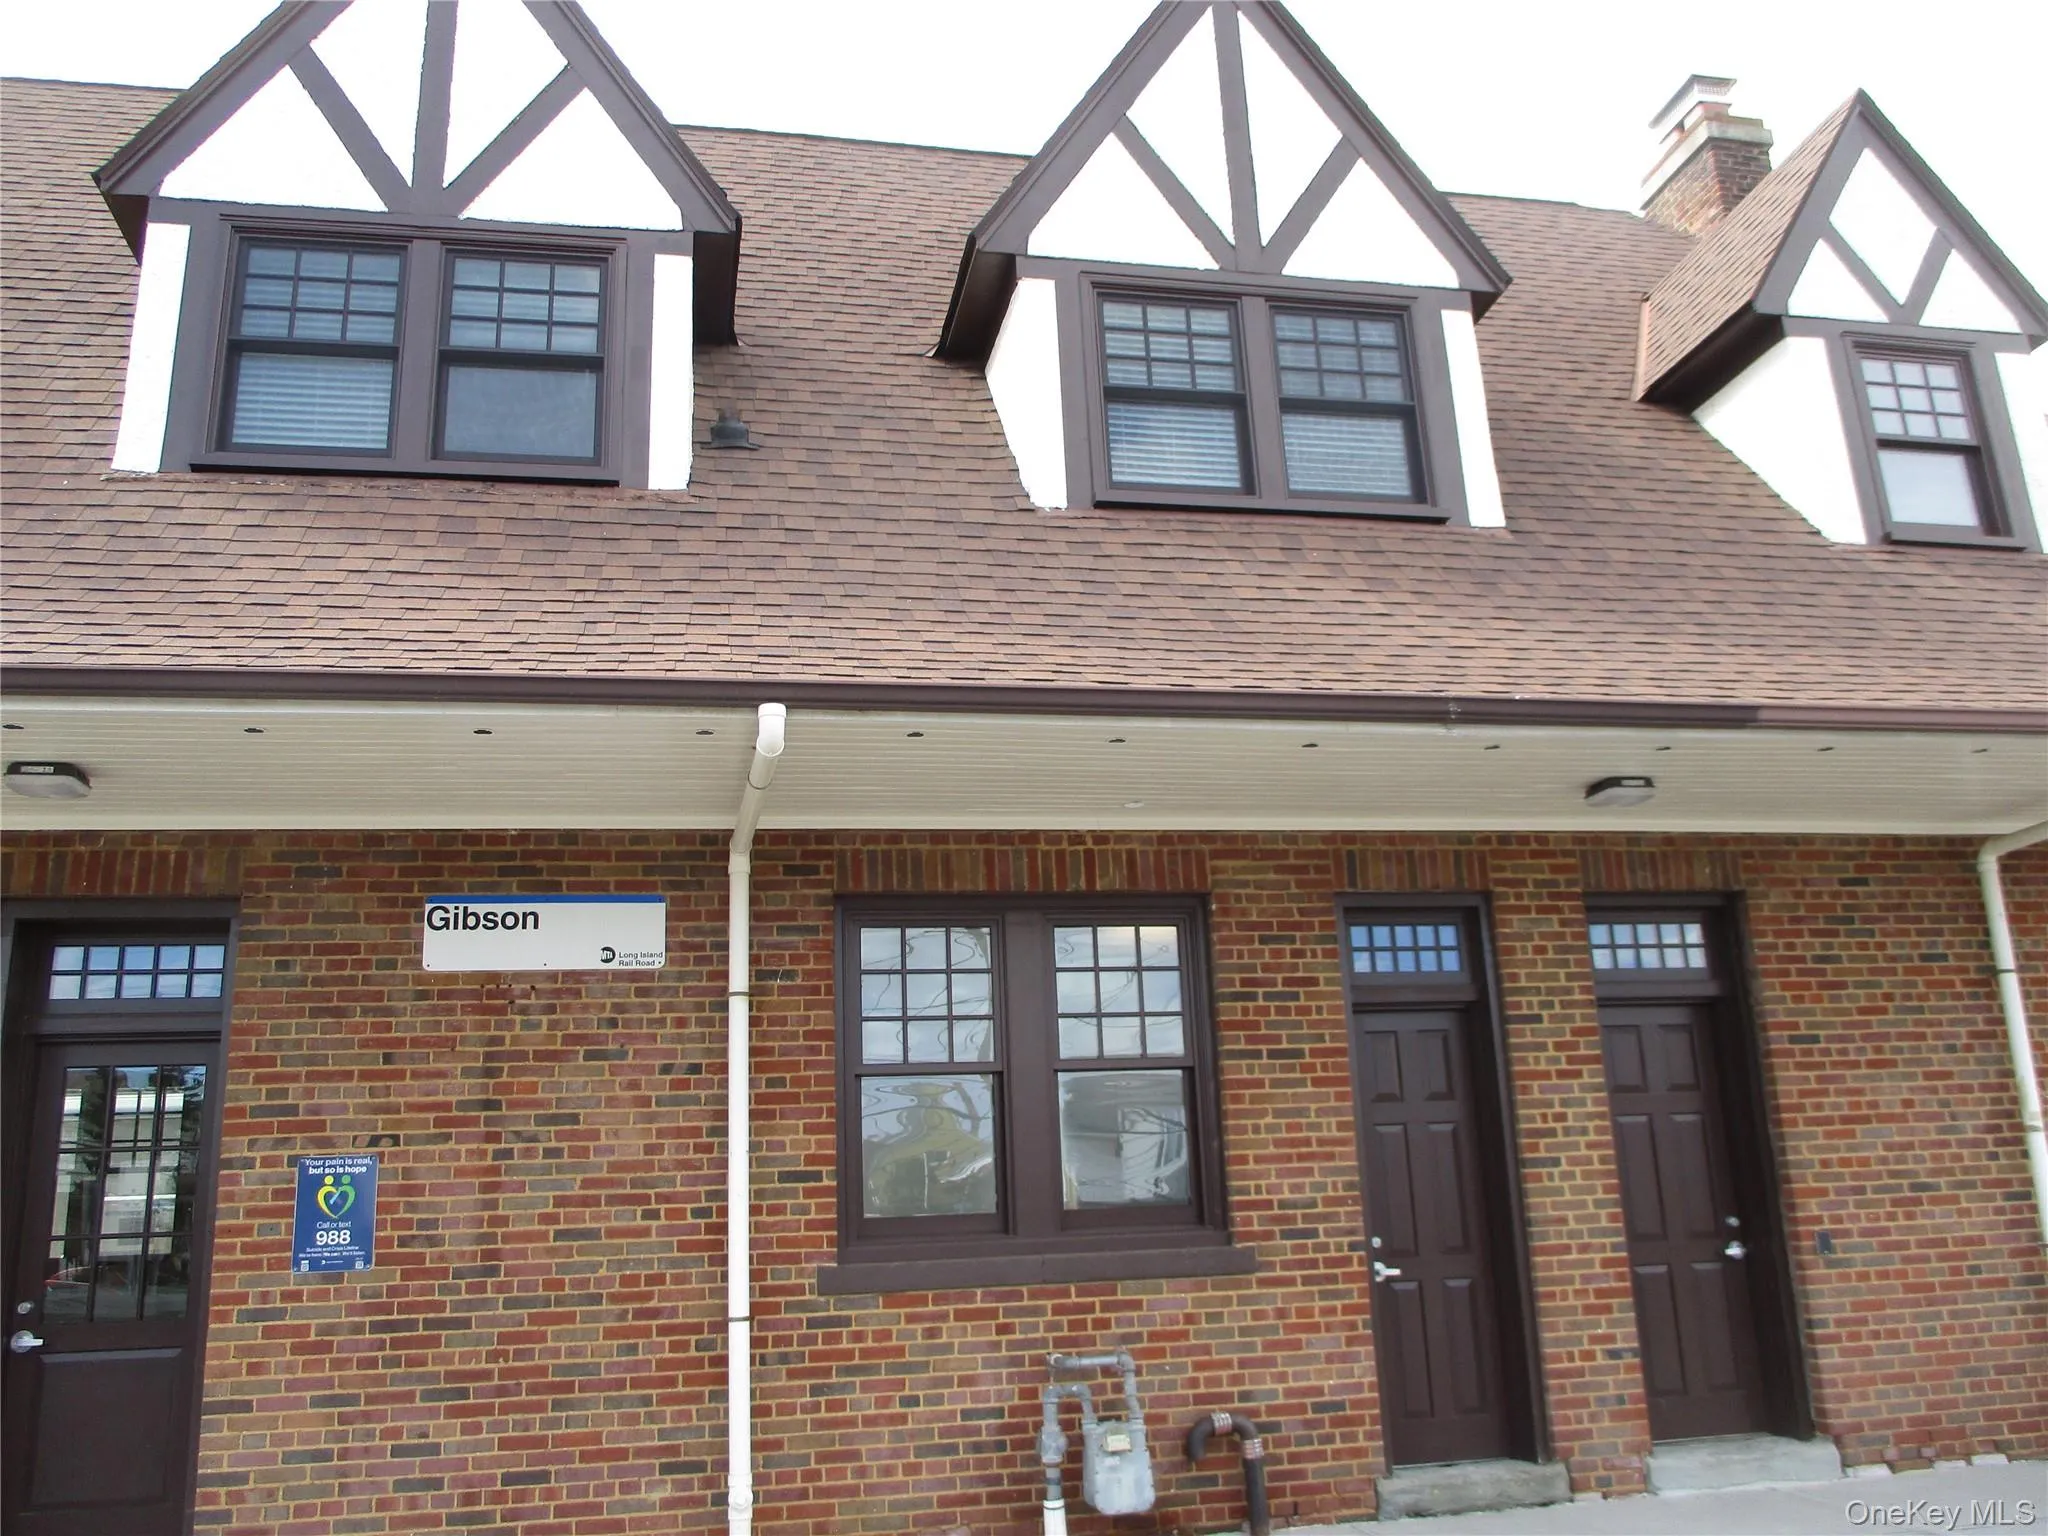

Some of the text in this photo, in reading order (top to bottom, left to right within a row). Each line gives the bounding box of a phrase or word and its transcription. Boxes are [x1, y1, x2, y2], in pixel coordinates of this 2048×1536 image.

[426, 905, 540, 931] Gibson
[618, 951, 639, 960] Long
[640, 951, 664, 959] Island
[618, 959, 656, 967] Rail Road
[305, 1156, 373, 1167] Your pain is real,
[308, 1166, 323, 1175] but
[336, 1165, 344, 1173] is
[345, 1165, 367, 1174] hope
[316, 1221, 330, 1229] Call
[338, 1220, 352, 1228] text
[316, 1229, 351, 1246] 988
